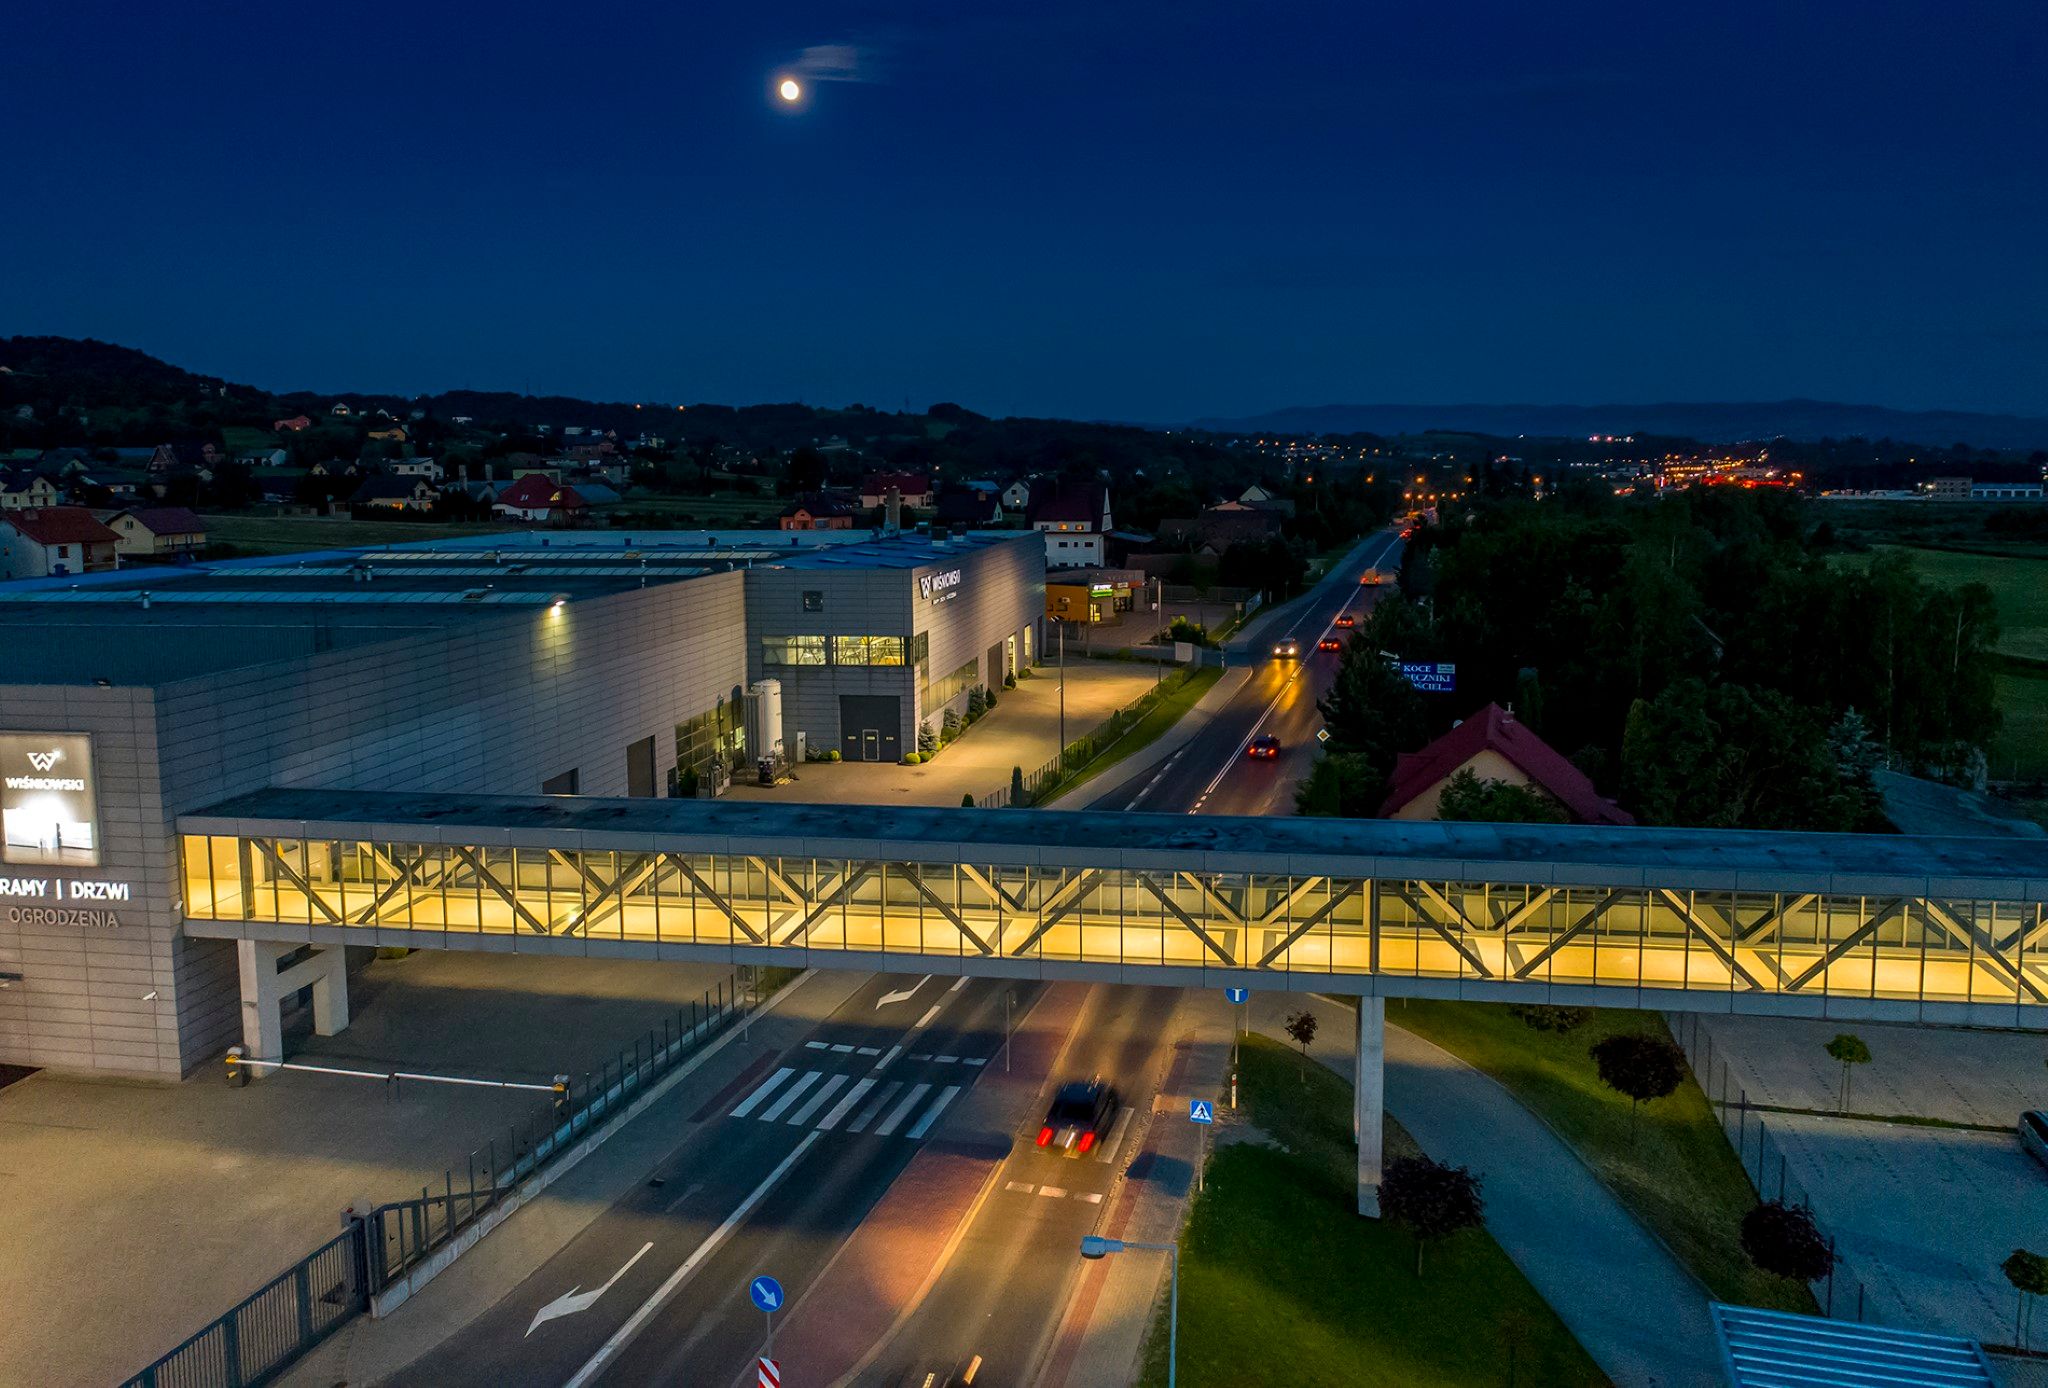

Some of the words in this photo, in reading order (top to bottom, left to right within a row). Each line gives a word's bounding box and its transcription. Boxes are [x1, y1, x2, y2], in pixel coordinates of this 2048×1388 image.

[1403, 664, 1431, 673] KOCE
[5, 775, 85, 791] WIŚNIOWSKI
[0, 878, 47, 897] RAMY
[71, 881, 129, 901] DRZWI
[8, 907, 120, 928] OGRODZENIA
